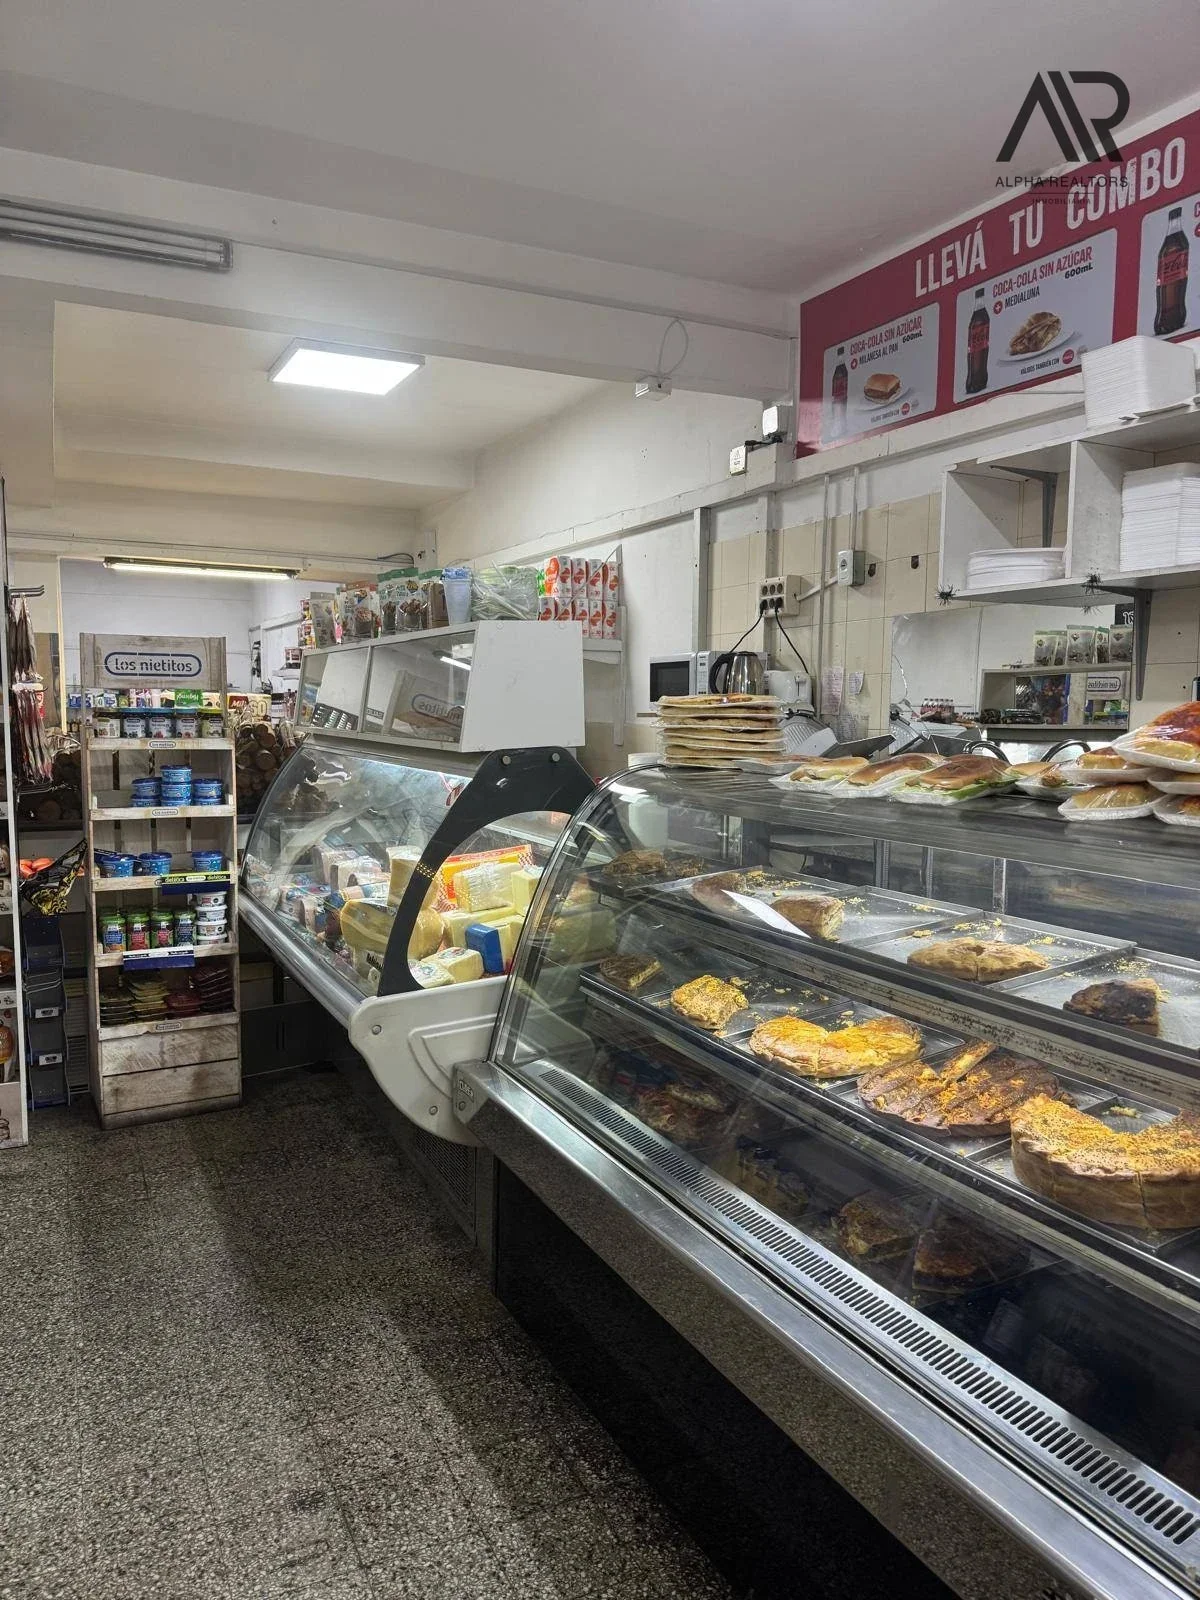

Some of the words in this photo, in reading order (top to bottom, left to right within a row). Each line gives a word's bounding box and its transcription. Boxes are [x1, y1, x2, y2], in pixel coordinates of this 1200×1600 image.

[915, 220, 988, 299] LLEVÁ
[1008, 198, 1045, 256] TU
[1066, 136, 1186, 230] COMBO
[992, 269, 1039, 298] COCA-COLA
[1039, 262, 1055, 280] SIN
[1055, 246, 1093, 272] AZÚCAR
[1064, 263, 1094, 279] 600mL
[1004, 285, 1041, 309] MEDIALUNA
[850, 331, 884, 355] COCA-COLA
[884, 328, 895, 341] SIN
[895, 315, 923, 337] AZÚCAR
[859, 348, 882, 365] MILANESA
[881, 346, 889, 358] AL
[888, 342, 899, 355] PAN
[140, 658, 192, 672] nietitos
